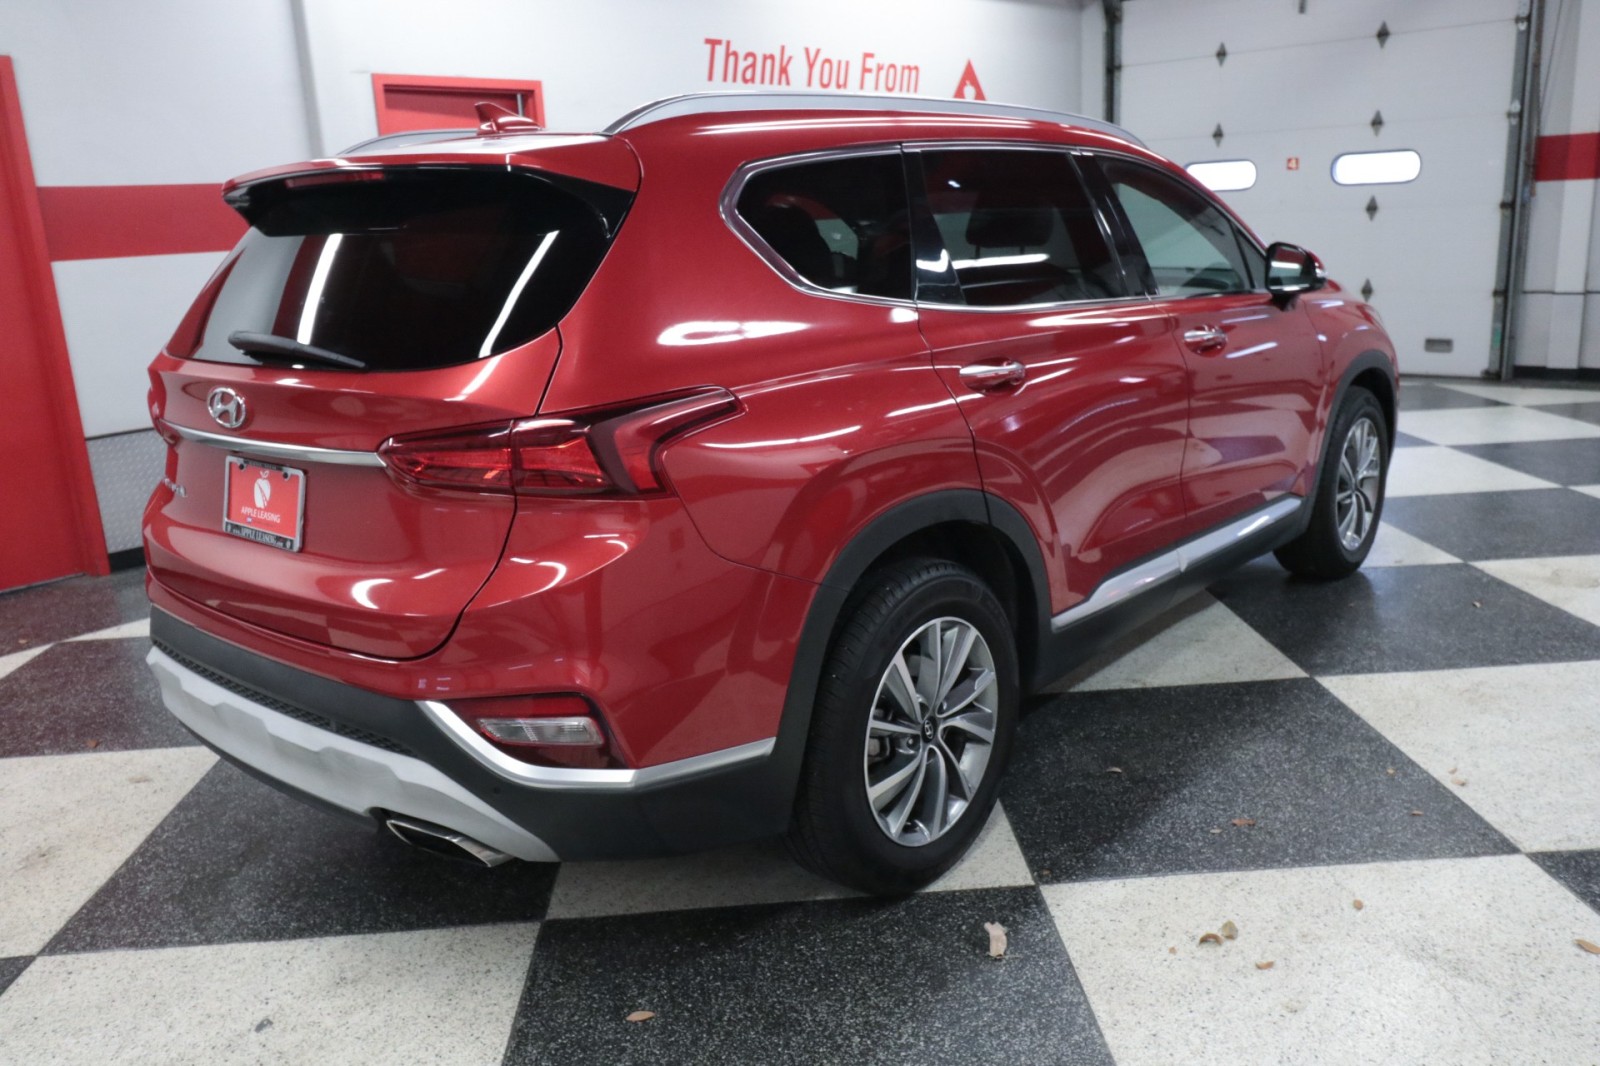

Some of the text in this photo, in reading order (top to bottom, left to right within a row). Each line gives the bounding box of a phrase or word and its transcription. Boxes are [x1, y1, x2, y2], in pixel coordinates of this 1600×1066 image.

[704, 38, 920, 93] Thank You From
[241, 506, 257, 519] APPLE
[257, 510, 281, 524] LEASING
